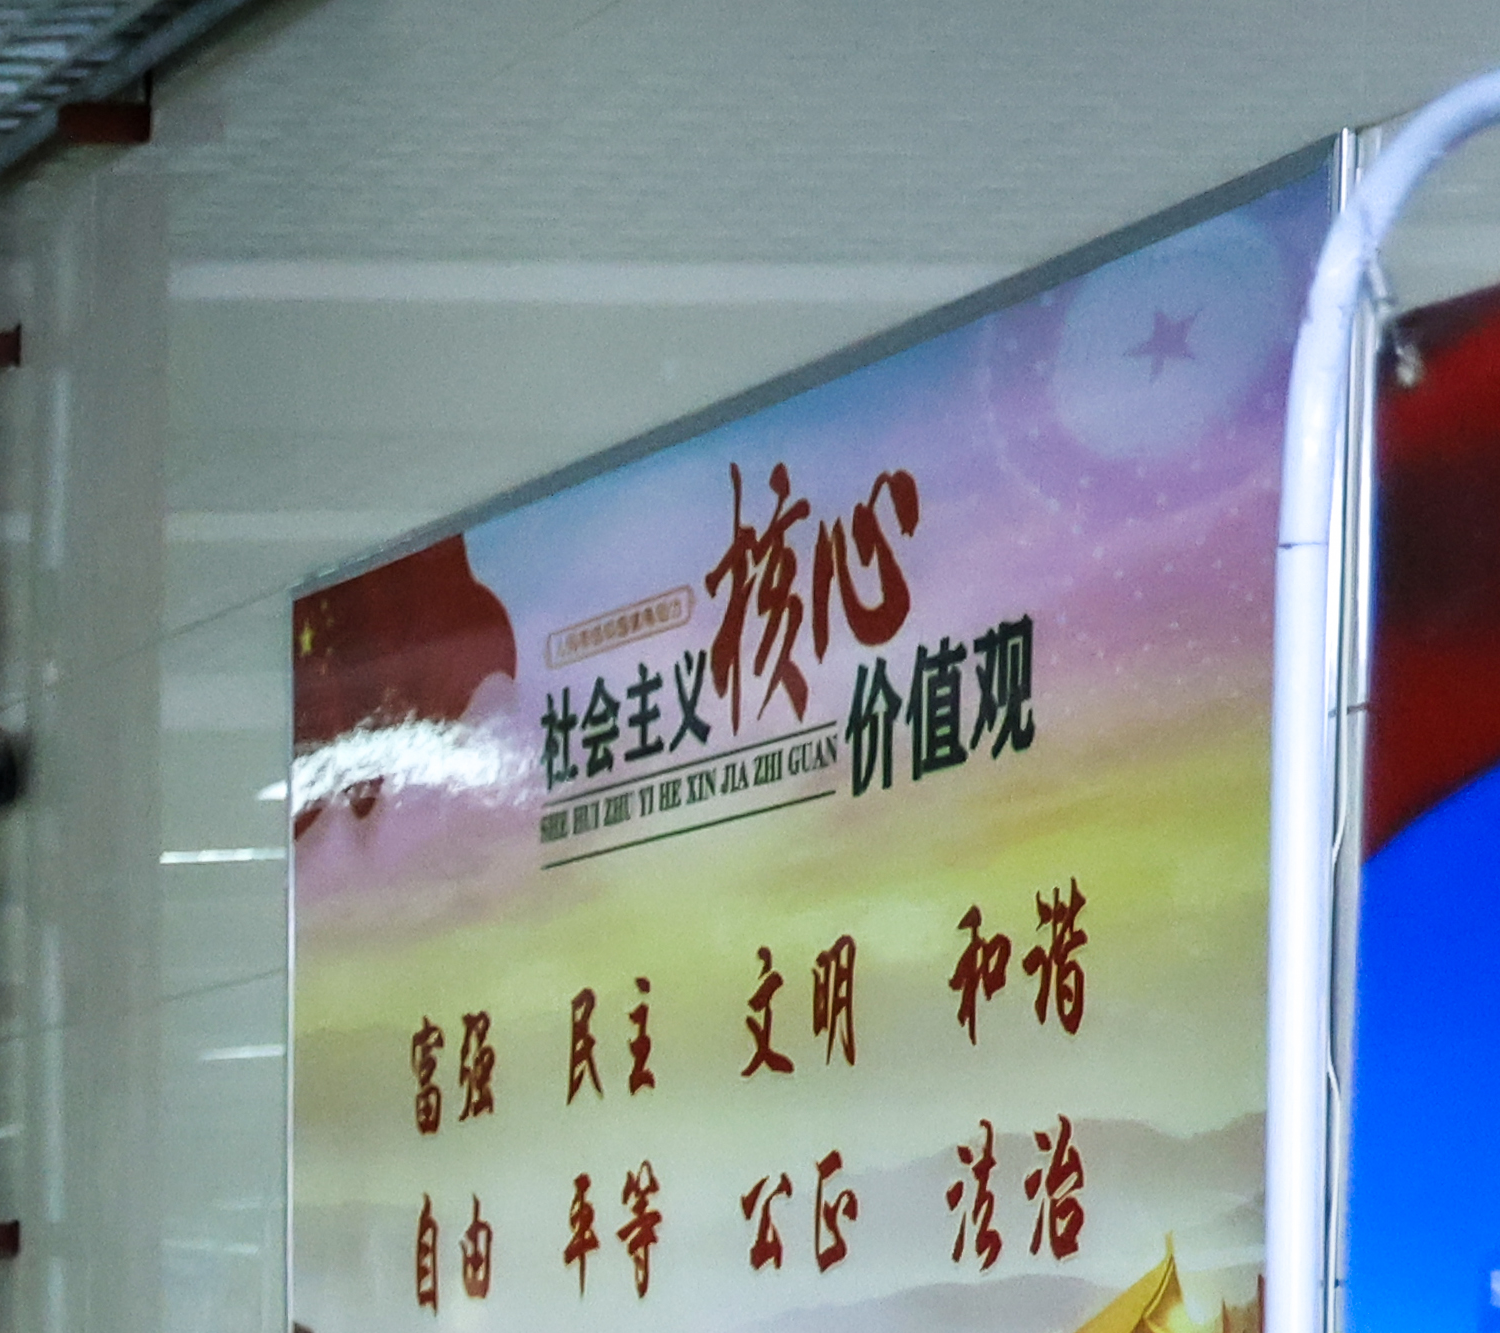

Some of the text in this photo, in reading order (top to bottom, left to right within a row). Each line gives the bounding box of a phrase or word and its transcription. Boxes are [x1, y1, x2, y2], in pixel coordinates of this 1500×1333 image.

[539, 462, 1036, 798] 社会主义 核心 价值观
[639, 785, 655, 817] YI
[659, 777, 682, 811] HE
[686, 768, 717, 804] XIN
[721, 760, 749, 794] JIA
[753, 749, 784, 786] ZHI
[788, 734, 838, 776] GUAN
[411, 876, 1089, 1135] 富强 民主 文明 和谐
[415, 1113, 1086, 1317] 自由 平等 公正 法治
